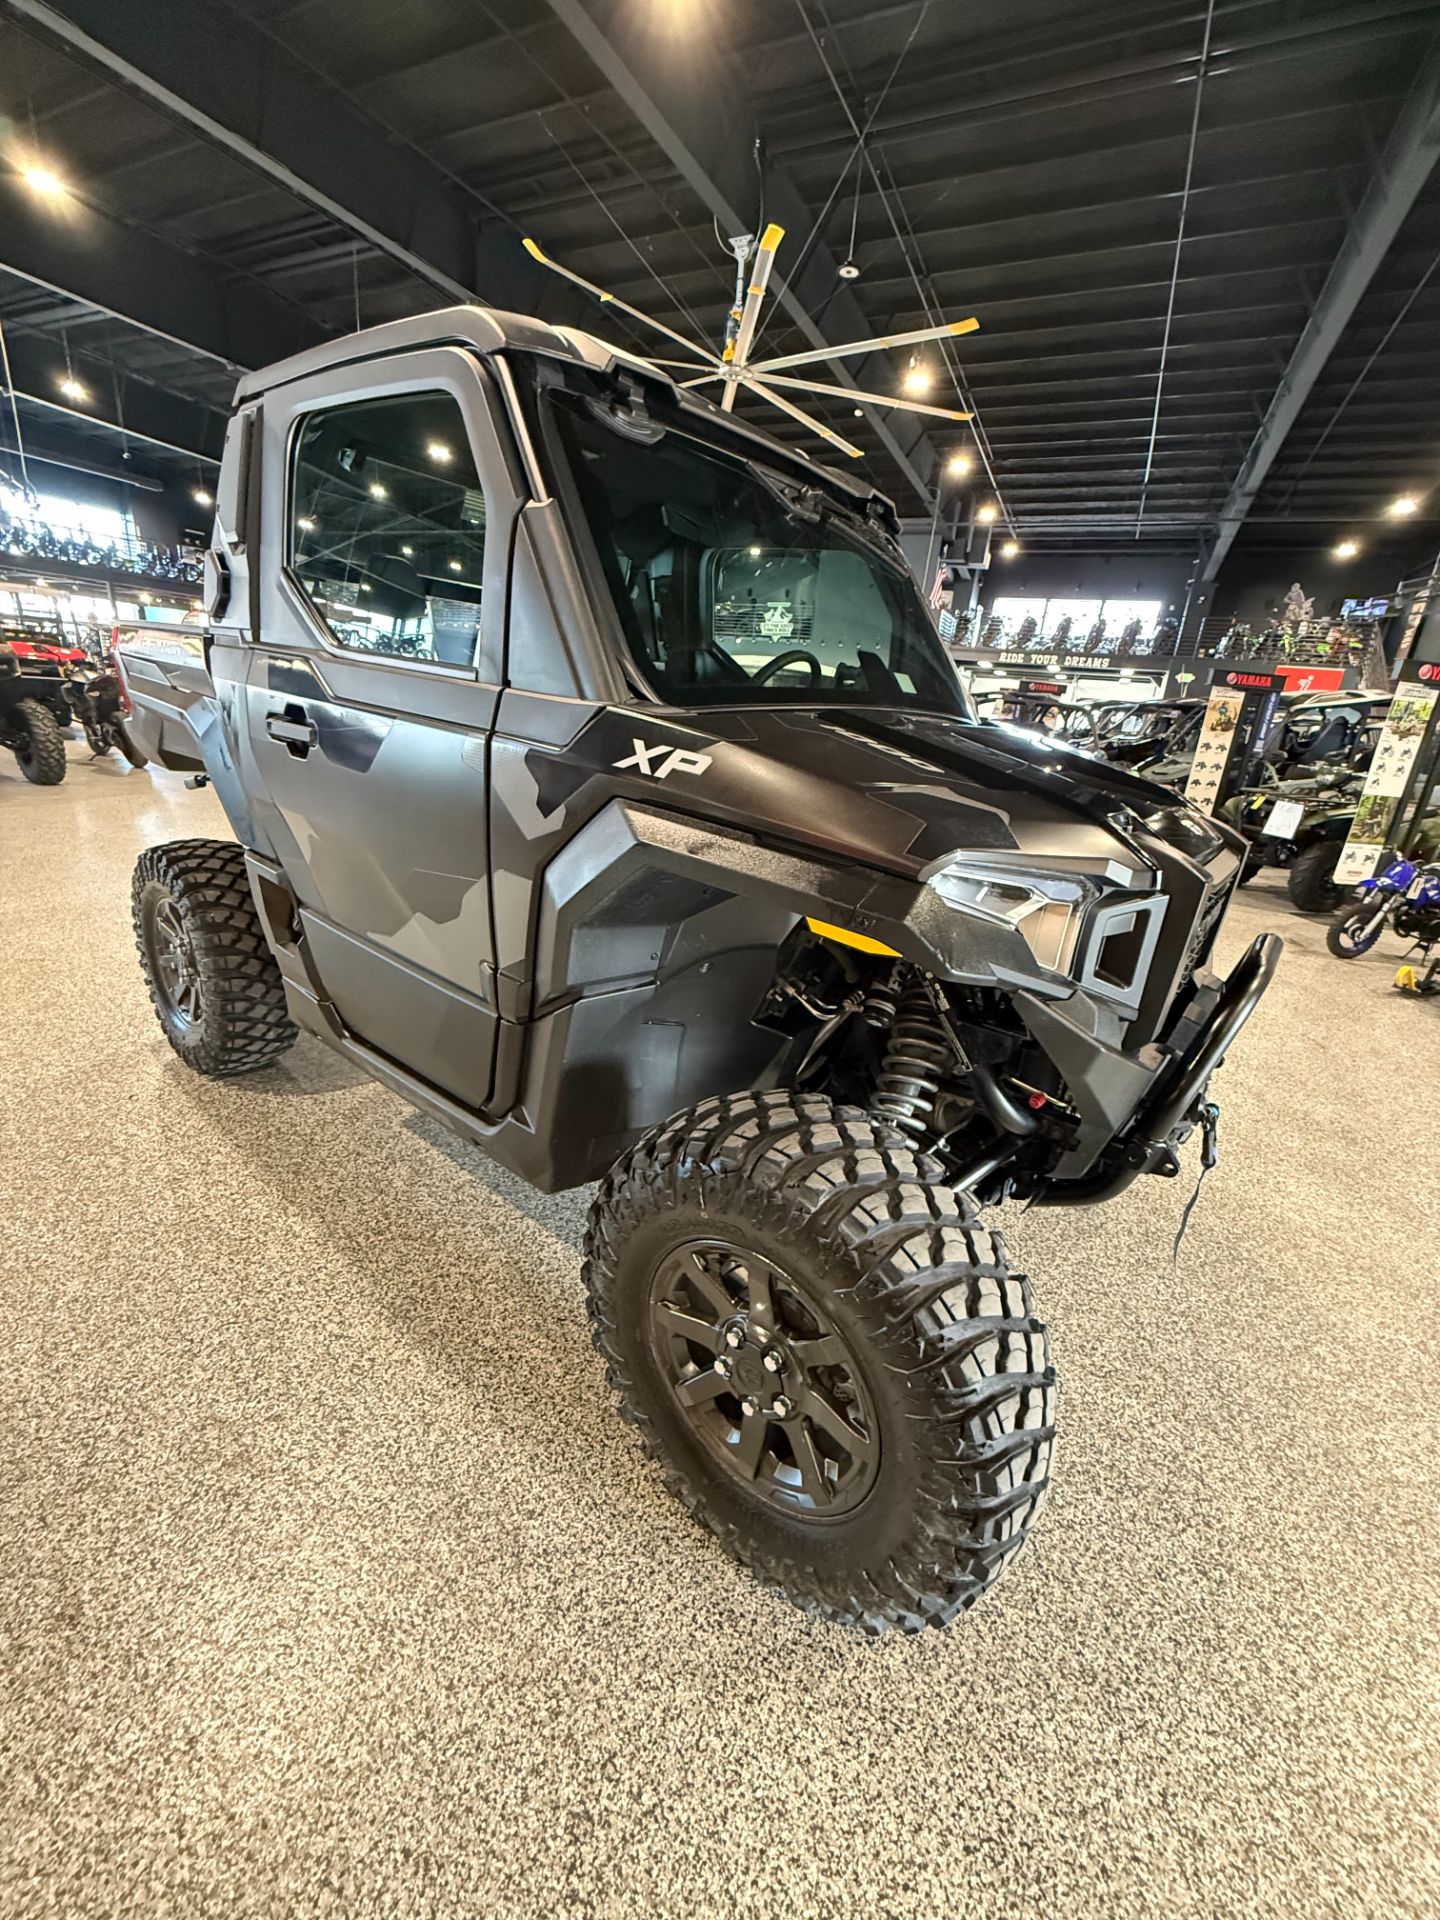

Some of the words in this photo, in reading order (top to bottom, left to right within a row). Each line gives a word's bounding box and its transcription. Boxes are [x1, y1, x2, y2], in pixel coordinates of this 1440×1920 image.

[999, 652, 1025, 663] RIDE
[1030, 653, 1058, 665] YOUR
[1064, 656, 1110, 667] DREAMS
[1236, 673, 1272, 687] YAMAHA
[611, 738, 713, 778] XP
